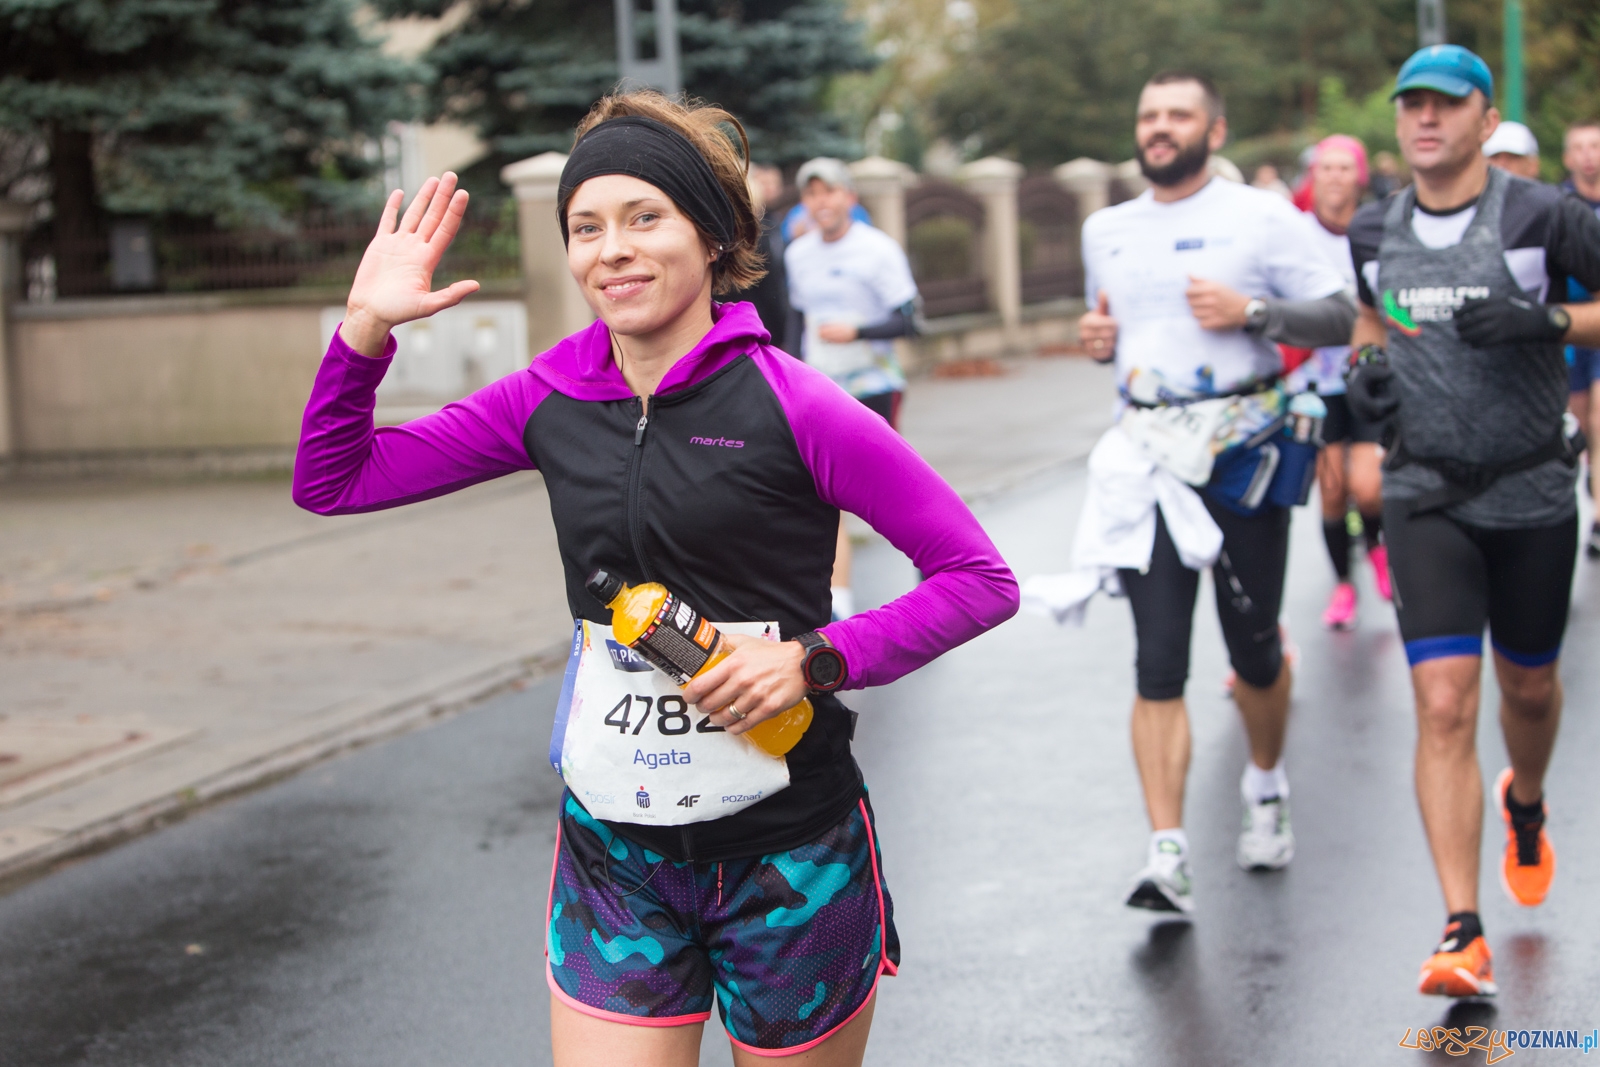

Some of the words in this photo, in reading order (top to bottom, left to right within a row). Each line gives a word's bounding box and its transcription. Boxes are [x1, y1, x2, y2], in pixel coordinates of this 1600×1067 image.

[689, 436, 745, 448] martes
[633, 748, 691, 769] Agata
[676, 794, 701, 808] 4F
